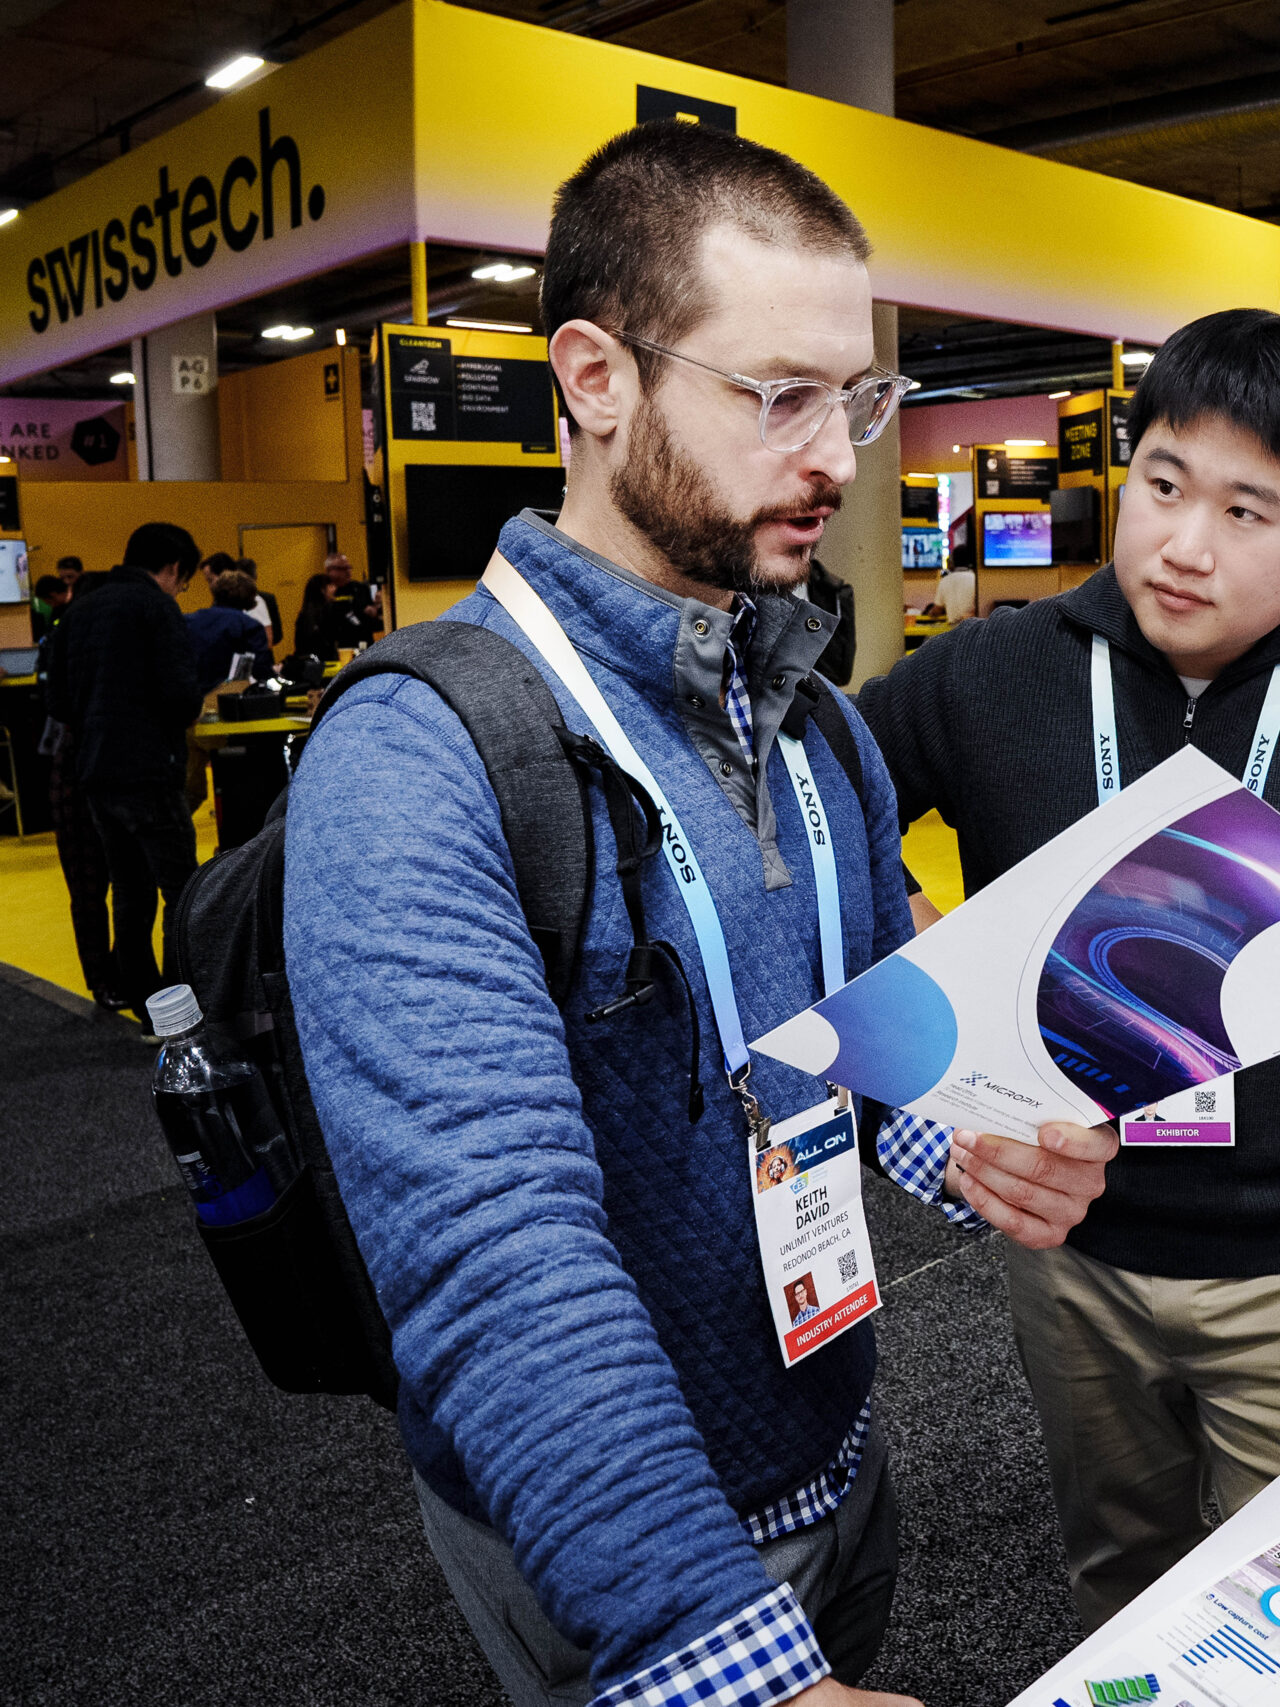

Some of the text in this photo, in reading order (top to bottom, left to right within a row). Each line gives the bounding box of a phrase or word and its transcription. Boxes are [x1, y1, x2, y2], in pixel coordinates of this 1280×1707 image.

[10, 422, 52, 439] ARE
[1065, 422, 1098, 442] MEETING
[1071, 442, 1092, 461] ZONE
[1100, 733, 1114, 790] SONY
[1247, 734, 1270, 792] SONY
[796, 772, 826, 846] SONY
[984, 1082, 1043, 1108] MICROPIX
[794, 1132, 847, 1165] ALL ON
[1156, 1129, 1200, 1137] EXHIBITOR
[795, 1185, 828, 1213] KEITH
[796, 1202, 830, 1230] DAVID
[780, 1211, 849, 1256] UNLIMIT VENTURES
[783, 1247, 817, 1272] REDONDO
[841, 1227, 851, 1239] CA
[796, 1293, 869, 1347] INDUSTRY ATTENDEE
[1213, 1598, 1270, 1641] Low capture cost
